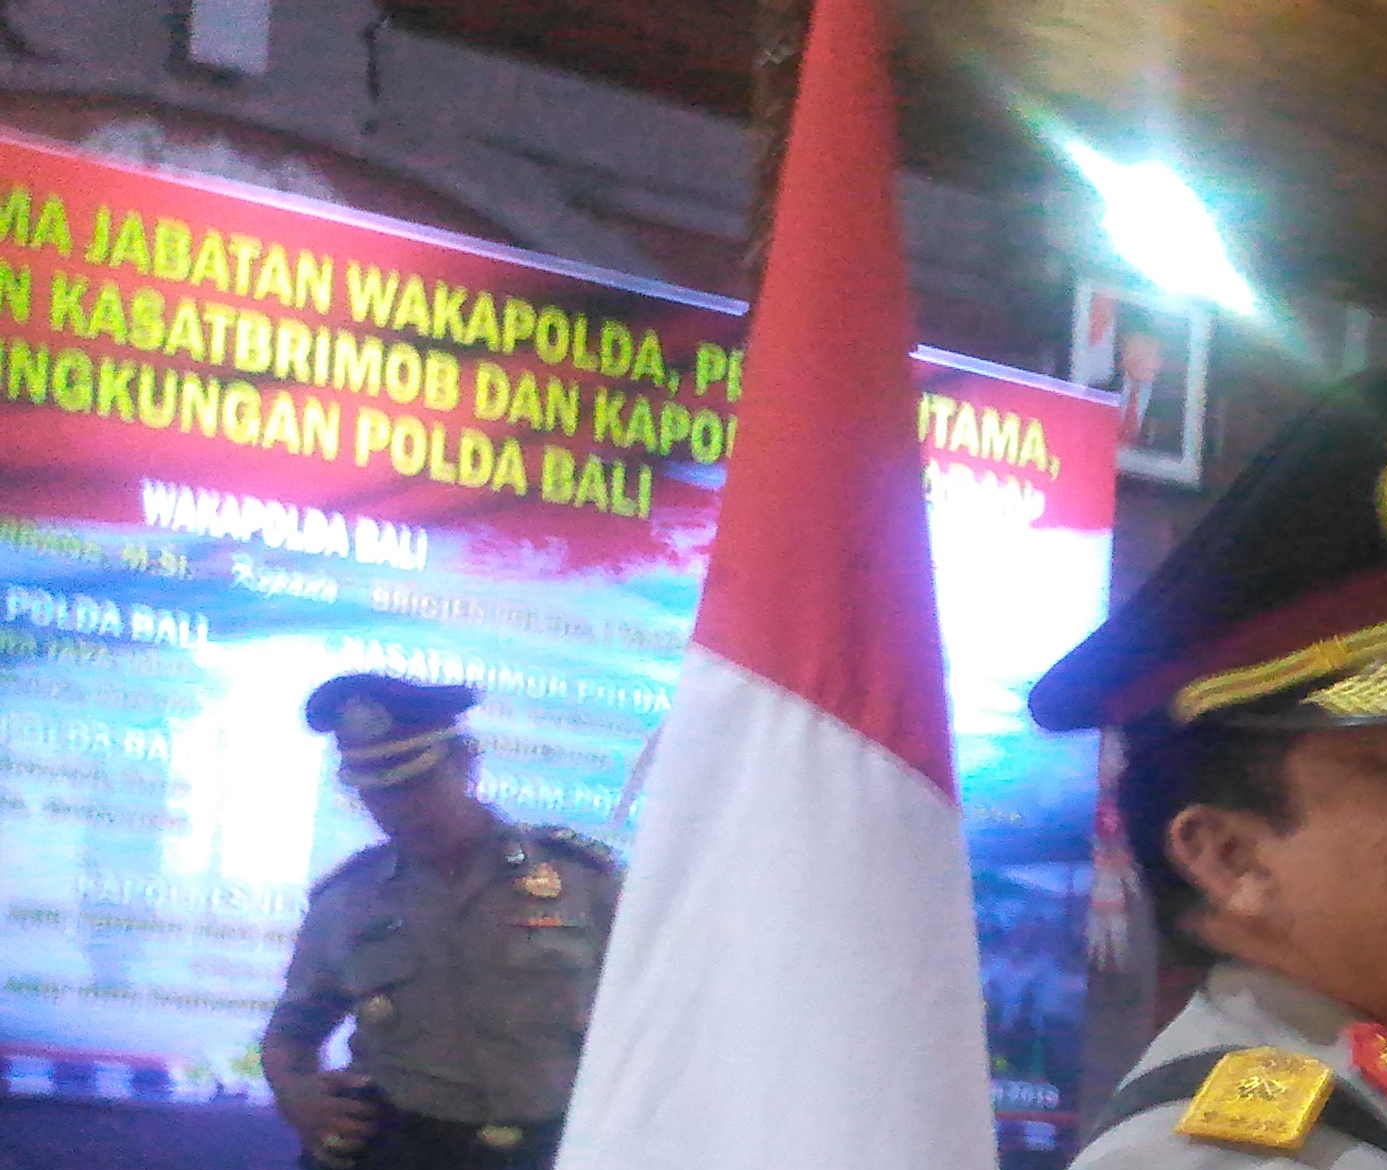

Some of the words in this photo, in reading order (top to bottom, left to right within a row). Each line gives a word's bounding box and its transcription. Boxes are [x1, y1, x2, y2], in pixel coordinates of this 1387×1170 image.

[50, 270, 460, 411] KASATBRIMOB
[474, 360, 579, 436] DAN
[84, 206, 334, 314] JABATAN
[346, 258, 680, 396] WAKAPOLDA,
[0, 338, 340, 461] NGKUNGAN
[354, 406, 528, 497] POLDA
[541, 445, 653, 518] BALI
[141, 477, 350, 558] WAKAPOLDA
[355, 516, 428, 570] BALI
[6, 585, 122, 637] POLDA
